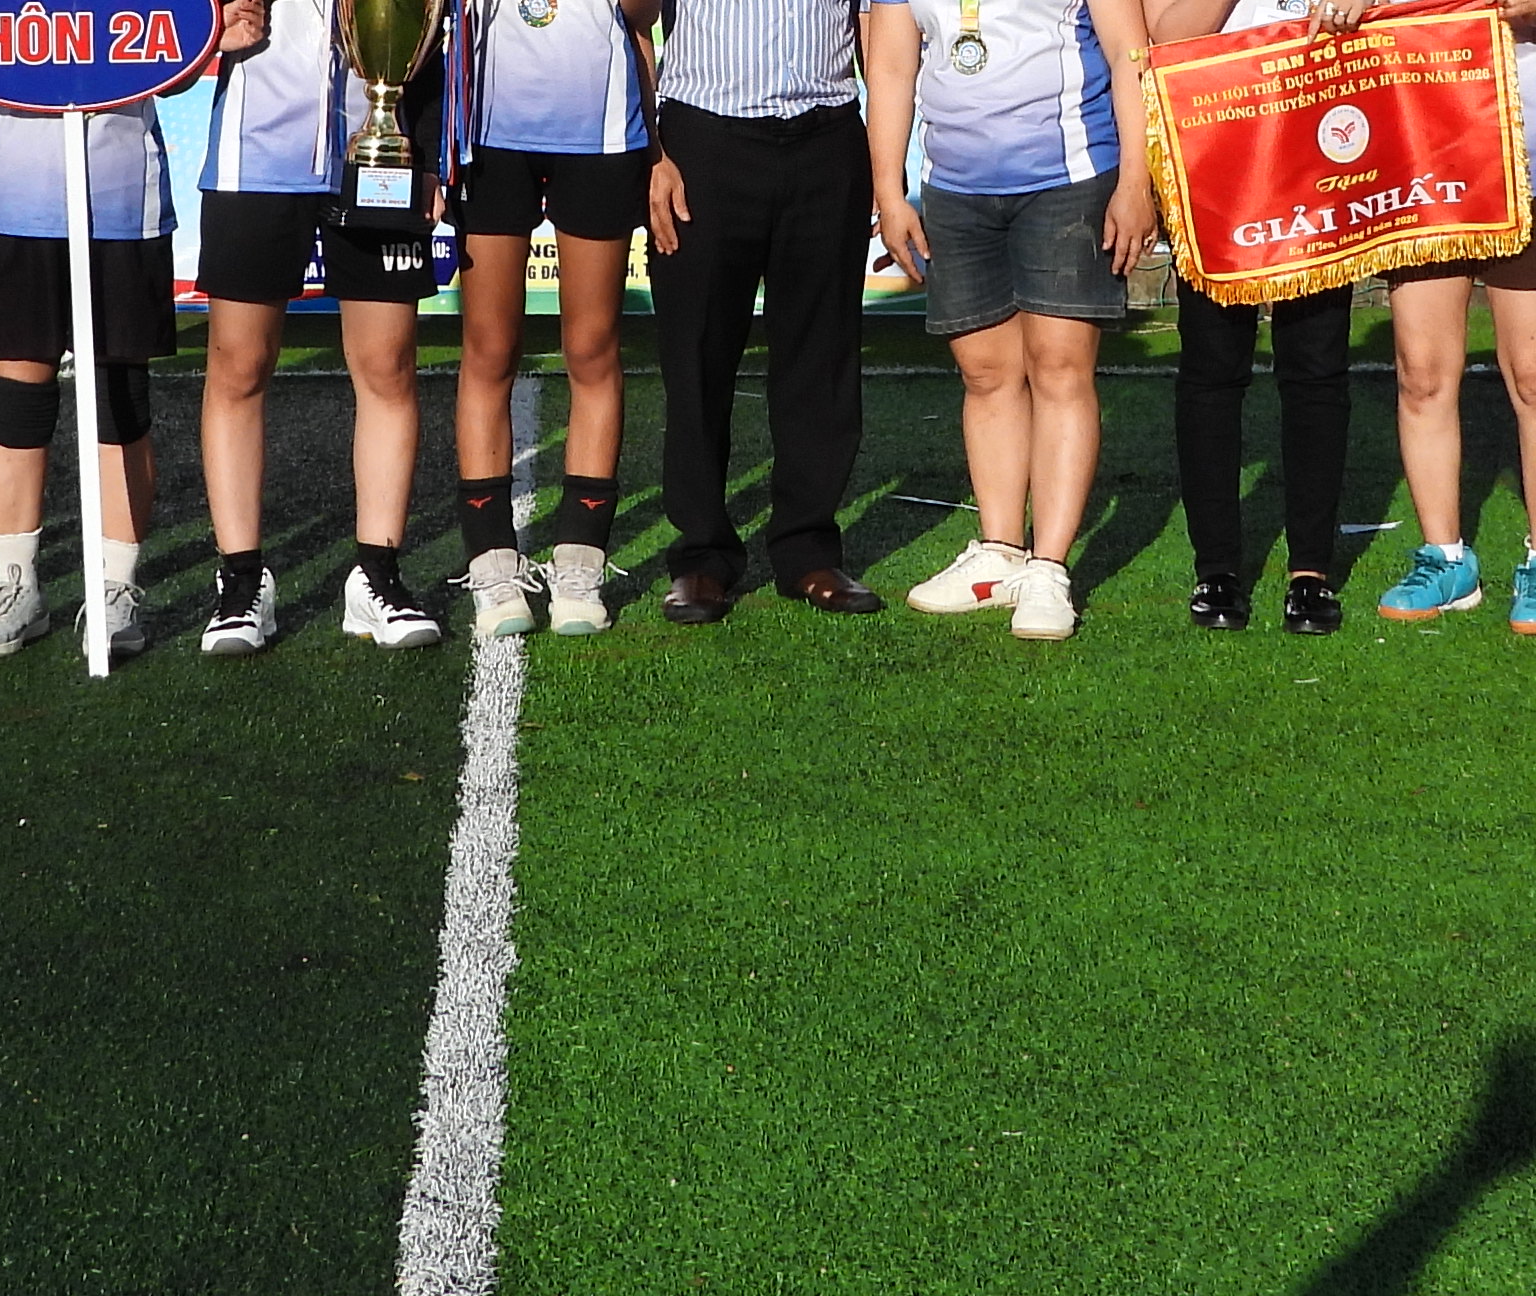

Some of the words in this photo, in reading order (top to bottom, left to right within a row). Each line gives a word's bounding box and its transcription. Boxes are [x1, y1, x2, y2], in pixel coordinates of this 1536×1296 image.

[109, 10, 183, 64] 2A
[1261, 53, 1305, 75] BAN
[1310, 39, 1337, 64] TỔ
[1341, 33, 1396, 55] CHỨC
[1181, 108, 1213, 129] GIẢI
[1216, 106, 1256, 123] BÓNG
[1359, 78, 1377, 92] EA
[1424, 68, 1457, 84] NĂM
[1460, 68, 1490, 82] 2026
[1222, 85, 1249, 102] HỘI
[1285, 72, 1314, 91] DỤC
[1344, 54, 1381, 74] THAO
[1383, 50, 1402, 65] XÃ
[1406, 53, 1426, 65] EA
[1315, 167, 1379, 193] Tặng
[1232, 204, 1339, 248] GIẢI
[1347, 172, 1467, 226] NHẤT
[380, 241, 424, 272] VDC
